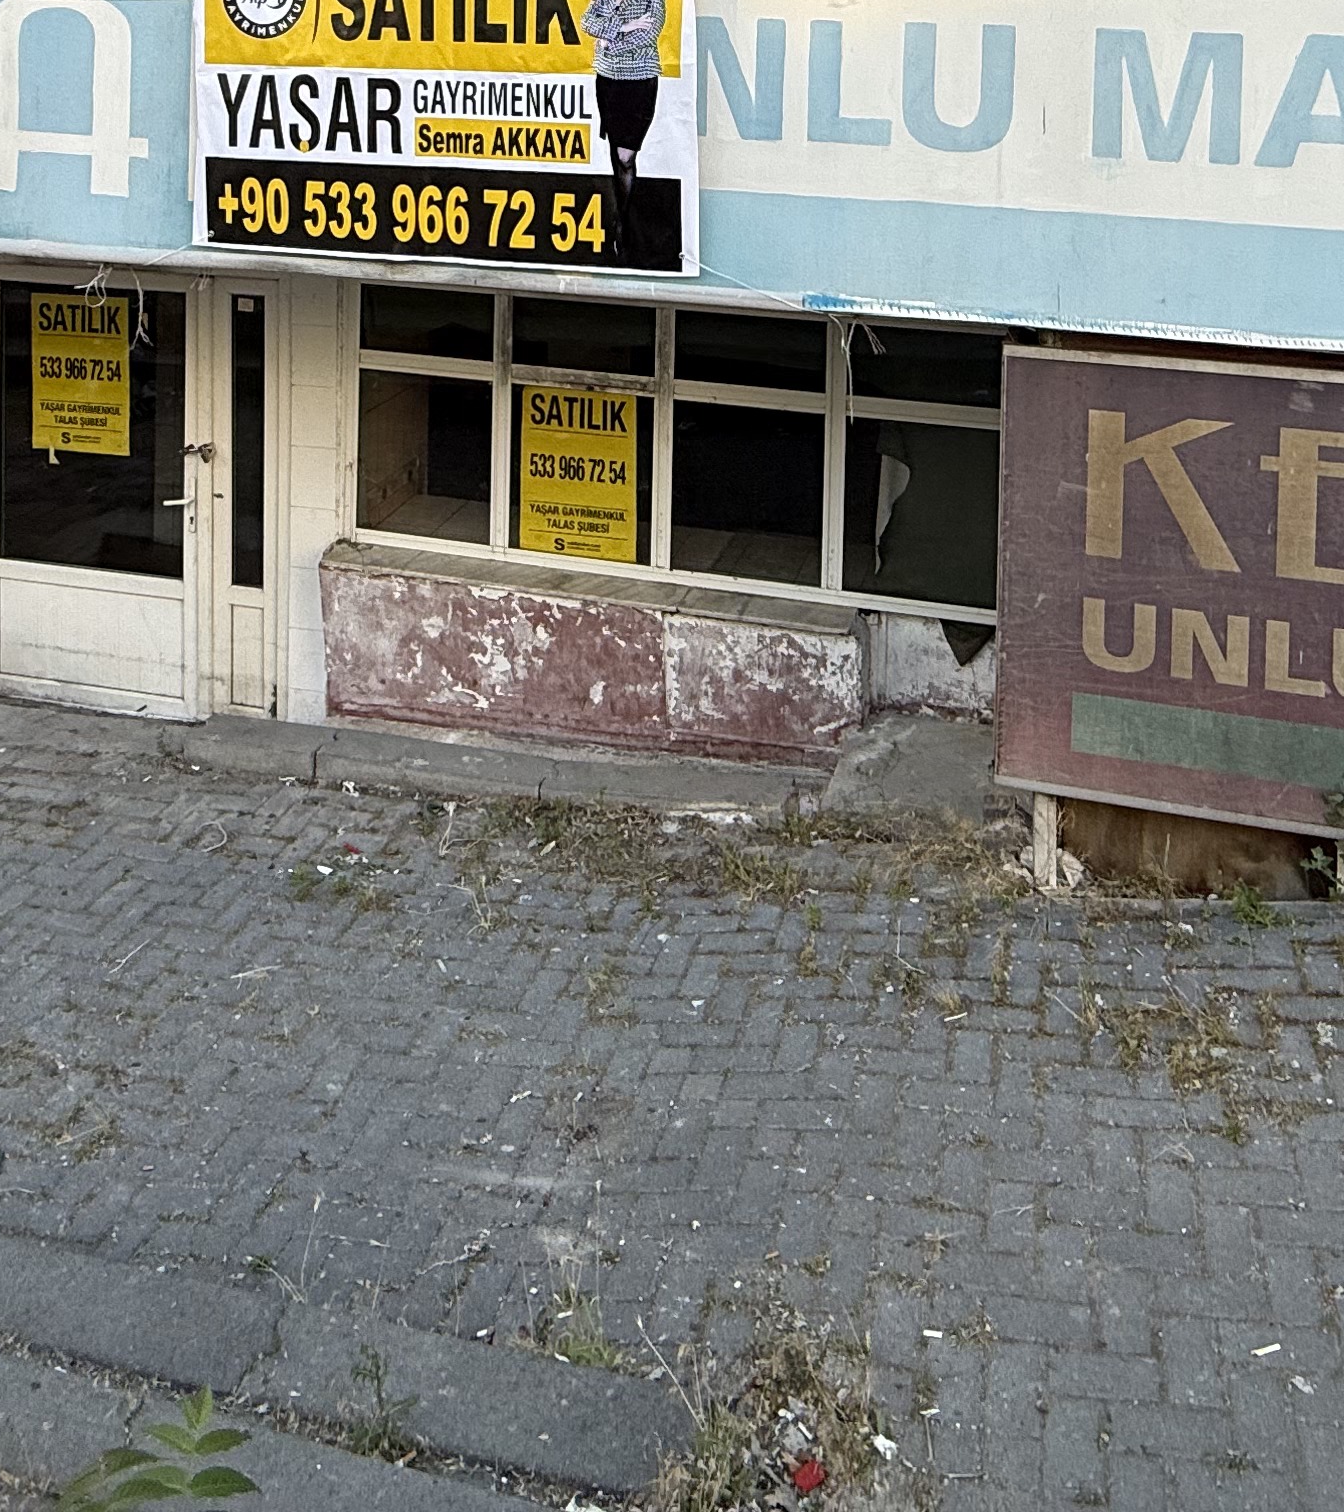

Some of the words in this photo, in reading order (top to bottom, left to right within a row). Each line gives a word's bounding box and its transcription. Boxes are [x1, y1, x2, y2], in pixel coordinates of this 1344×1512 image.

[696, 16, 1016, 152] NLU
[418, 124, 484, 155] Semra
[491, 127, 586, 159] AKKAYA
[218, 177, 288, 236] +90
[304, 180, 377, 242] 533
[393, 184, 469, 245] 966
[483, 190, 535, 250] 72
[552, 193, 605, 253] 54
[38, 303, 121, 334] SATILIK
[40, 356, 62, 378] 533
[65, 358, 87, 380] 966
[90, 359, 104, 381] 72
[107, 360, 121, 382] 54
[530, 393, 628, 433] SATILIK
[530, 453, 555, 478] 533
[559, 455, 585, 481] 966
[589, 458, 605, 483] 72
[609, 460, 626, 485] 54
[546, 518, 575, 530] TALAS
